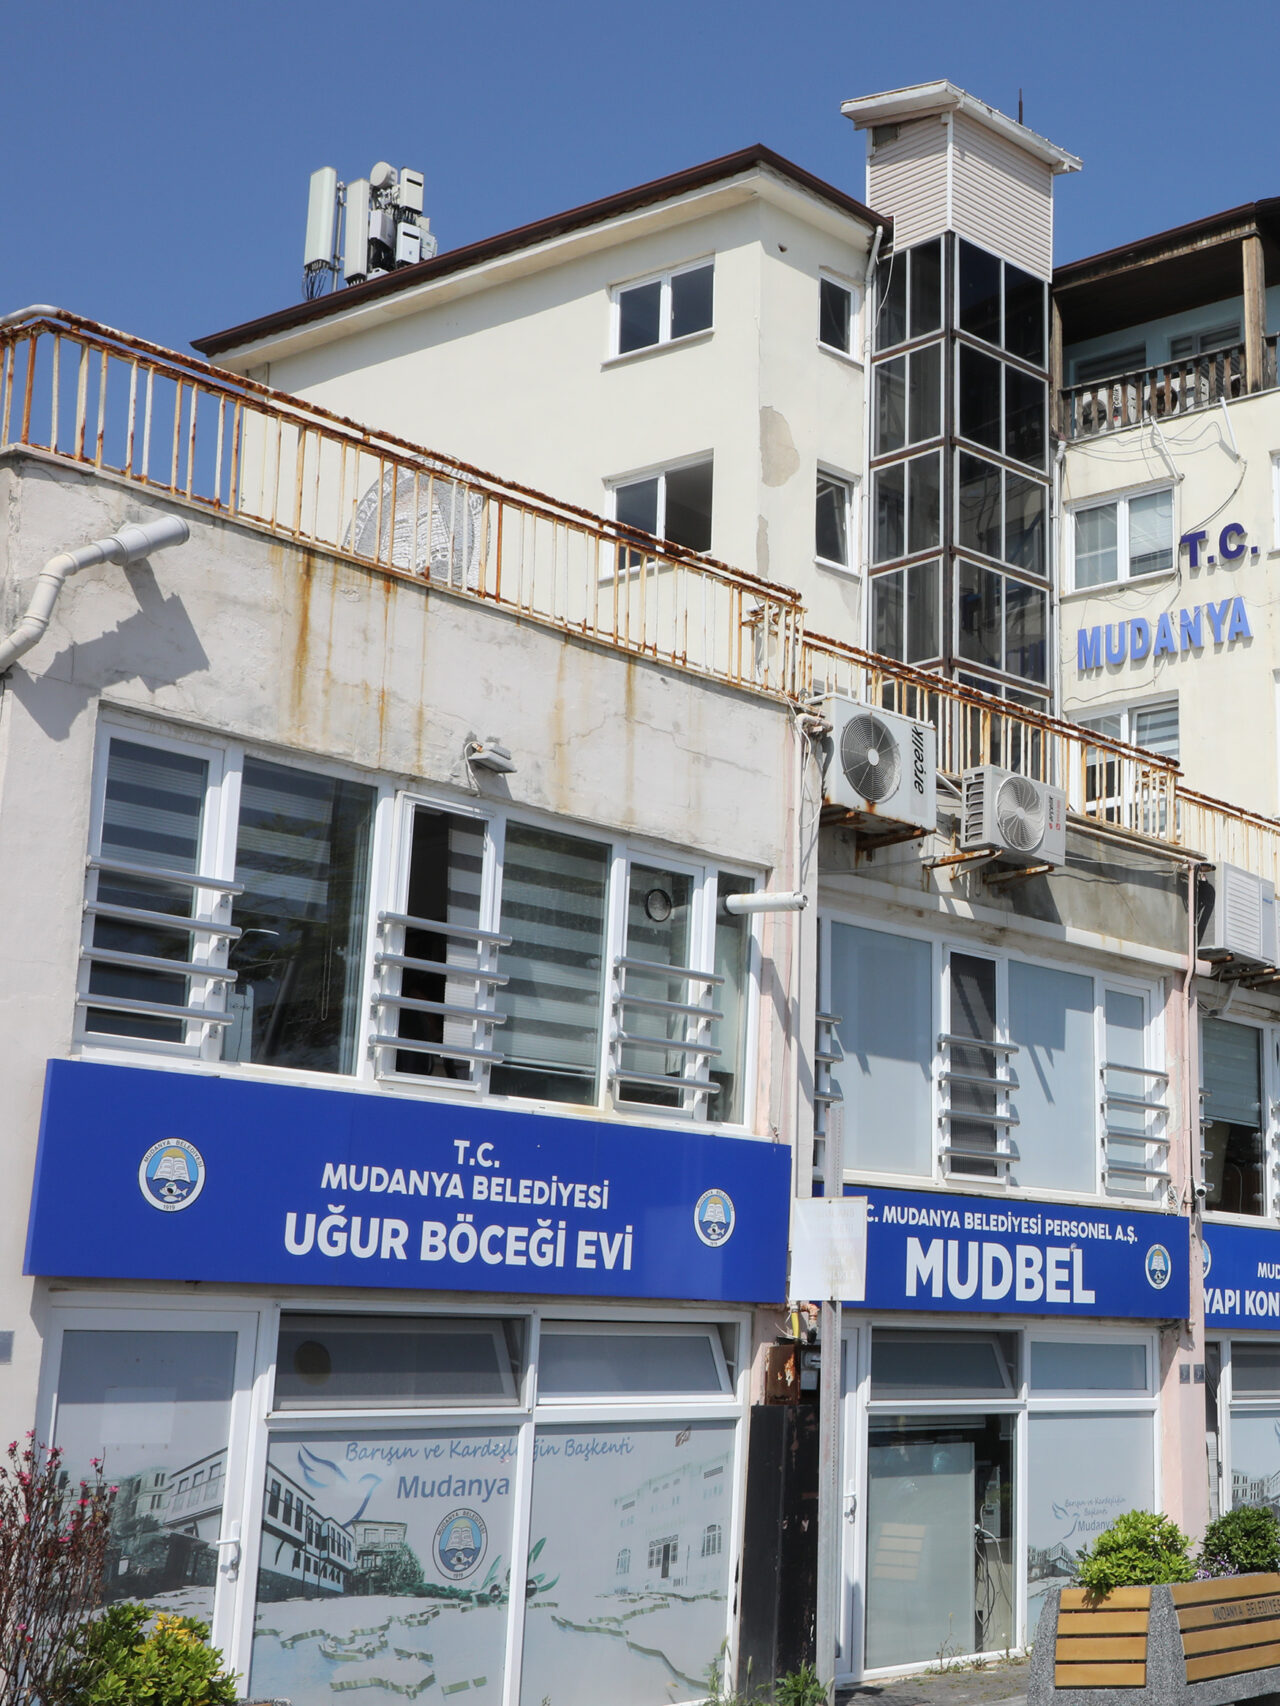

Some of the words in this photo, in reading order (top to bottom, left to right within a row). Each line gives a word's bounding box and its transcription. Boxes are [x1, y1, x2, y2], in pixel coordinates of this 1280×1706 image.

[1181, 521, 1259, 569] T.C.
[1077, 596, 1254, 671] MUDANYA
[911, 726, 924, 795] arçelik
[143, 1140, 171, 1163] MUDANYA
[454, 1139, 500, 1168] T.C.
[320, 1162, 465, 1199] MUDANYA
[472, 1175, 610, 1210] BELEDİYESİ
[284, 1204, 409, 1260] UĞUR
[420, 1213, 566, 1268] BÖCEĞİ
[576, 1224, 633, 1271] EVİ
[882, 1206, 961, 1229] MUDANYA
[964, 1211, 1043, 1235] BELEDİYESİ
[1045, 1222, 1113, 1242] PERSONEL
[1114, 1225, 1139, 1243] A.Ş.
[905, 1236, 1097, 1304] MUDBEL
[1203, 1287, 1241, 1316] YAPI
[345, 1442, 419, 1466] Barışın
[424, 1443, 441, 1459] ve
[449, 1438, 560, 1464] Kardeşlğin
[564, 1436, 635, 1461] Başkenti
[396, 1474, 510, 1503] Mudanya
